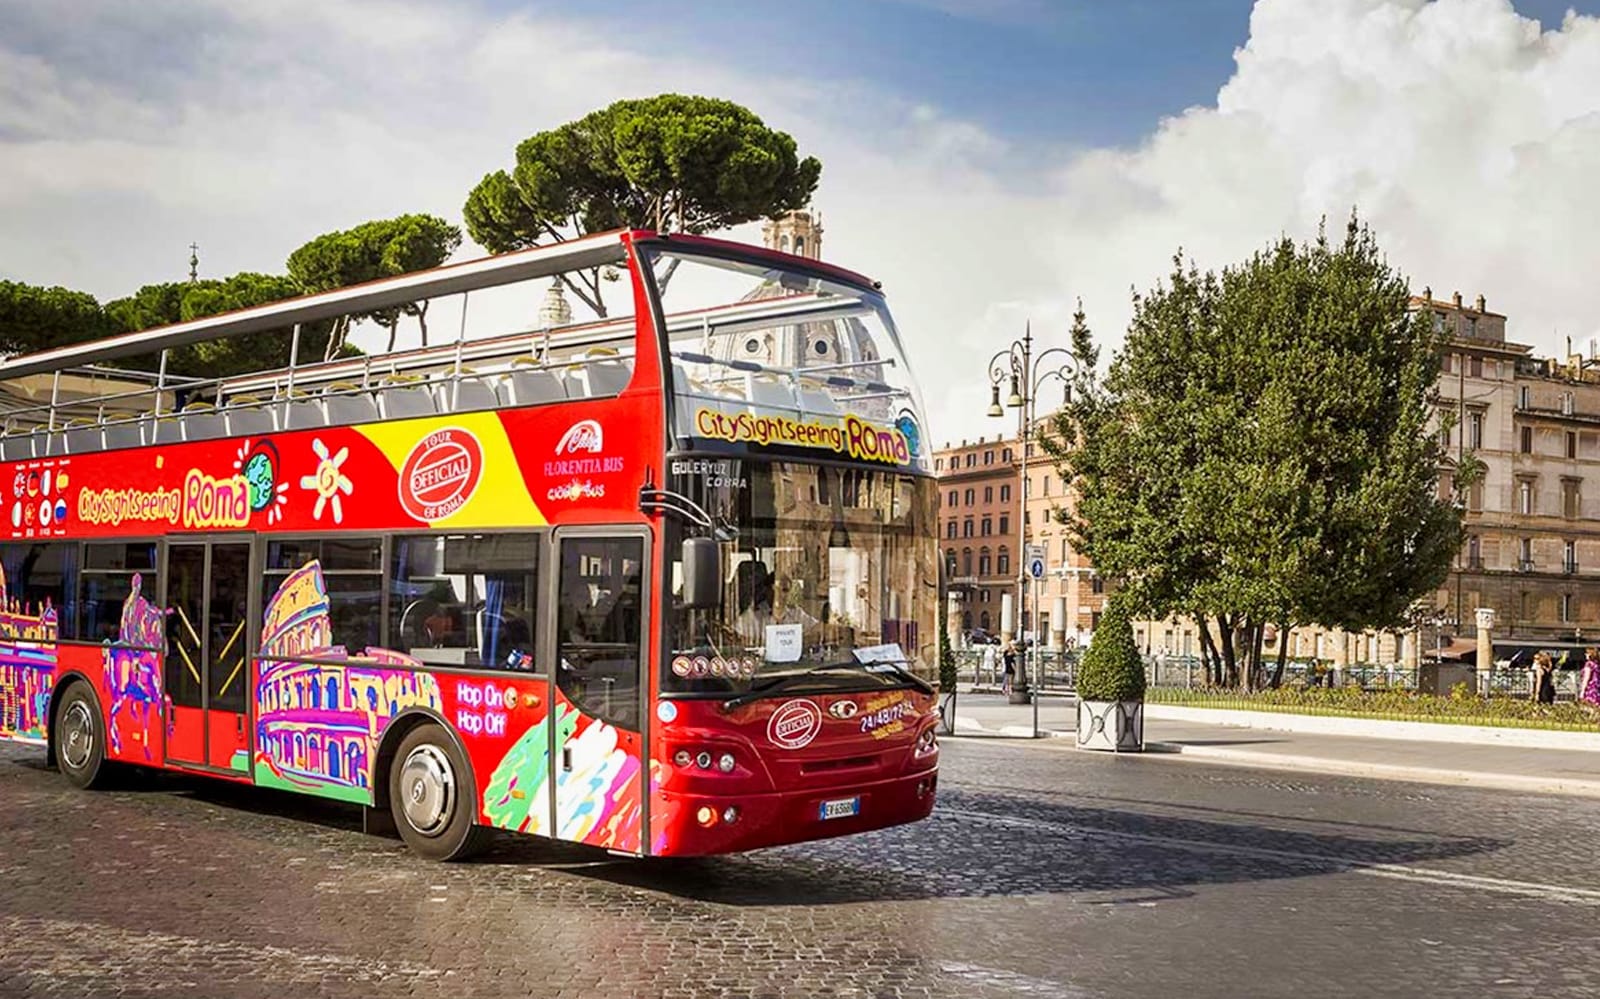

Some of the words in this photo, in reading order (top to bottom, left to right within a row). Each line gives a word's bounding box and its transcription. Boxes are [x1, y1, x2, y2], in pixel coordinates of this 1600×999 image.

[423, 431, 451, 449] TOUR
[694, 408, 842, 451] CitySightseeing
[413, 458, 468, 490] OFFICIAL
[544, 459, 602, 476] FLORENTIA
[603, 457, 624, 472] BUS
[706, 476, 747, 489] COBRA
[424, 506, 437, 519] OF
[437, 494, 465, 518] ROMA
[457, 683, 482, 707] Hop
[485, 684, 503, 706] On
[457, 711, 483, 734] Hop
[485, 711, 505, 735] Off
